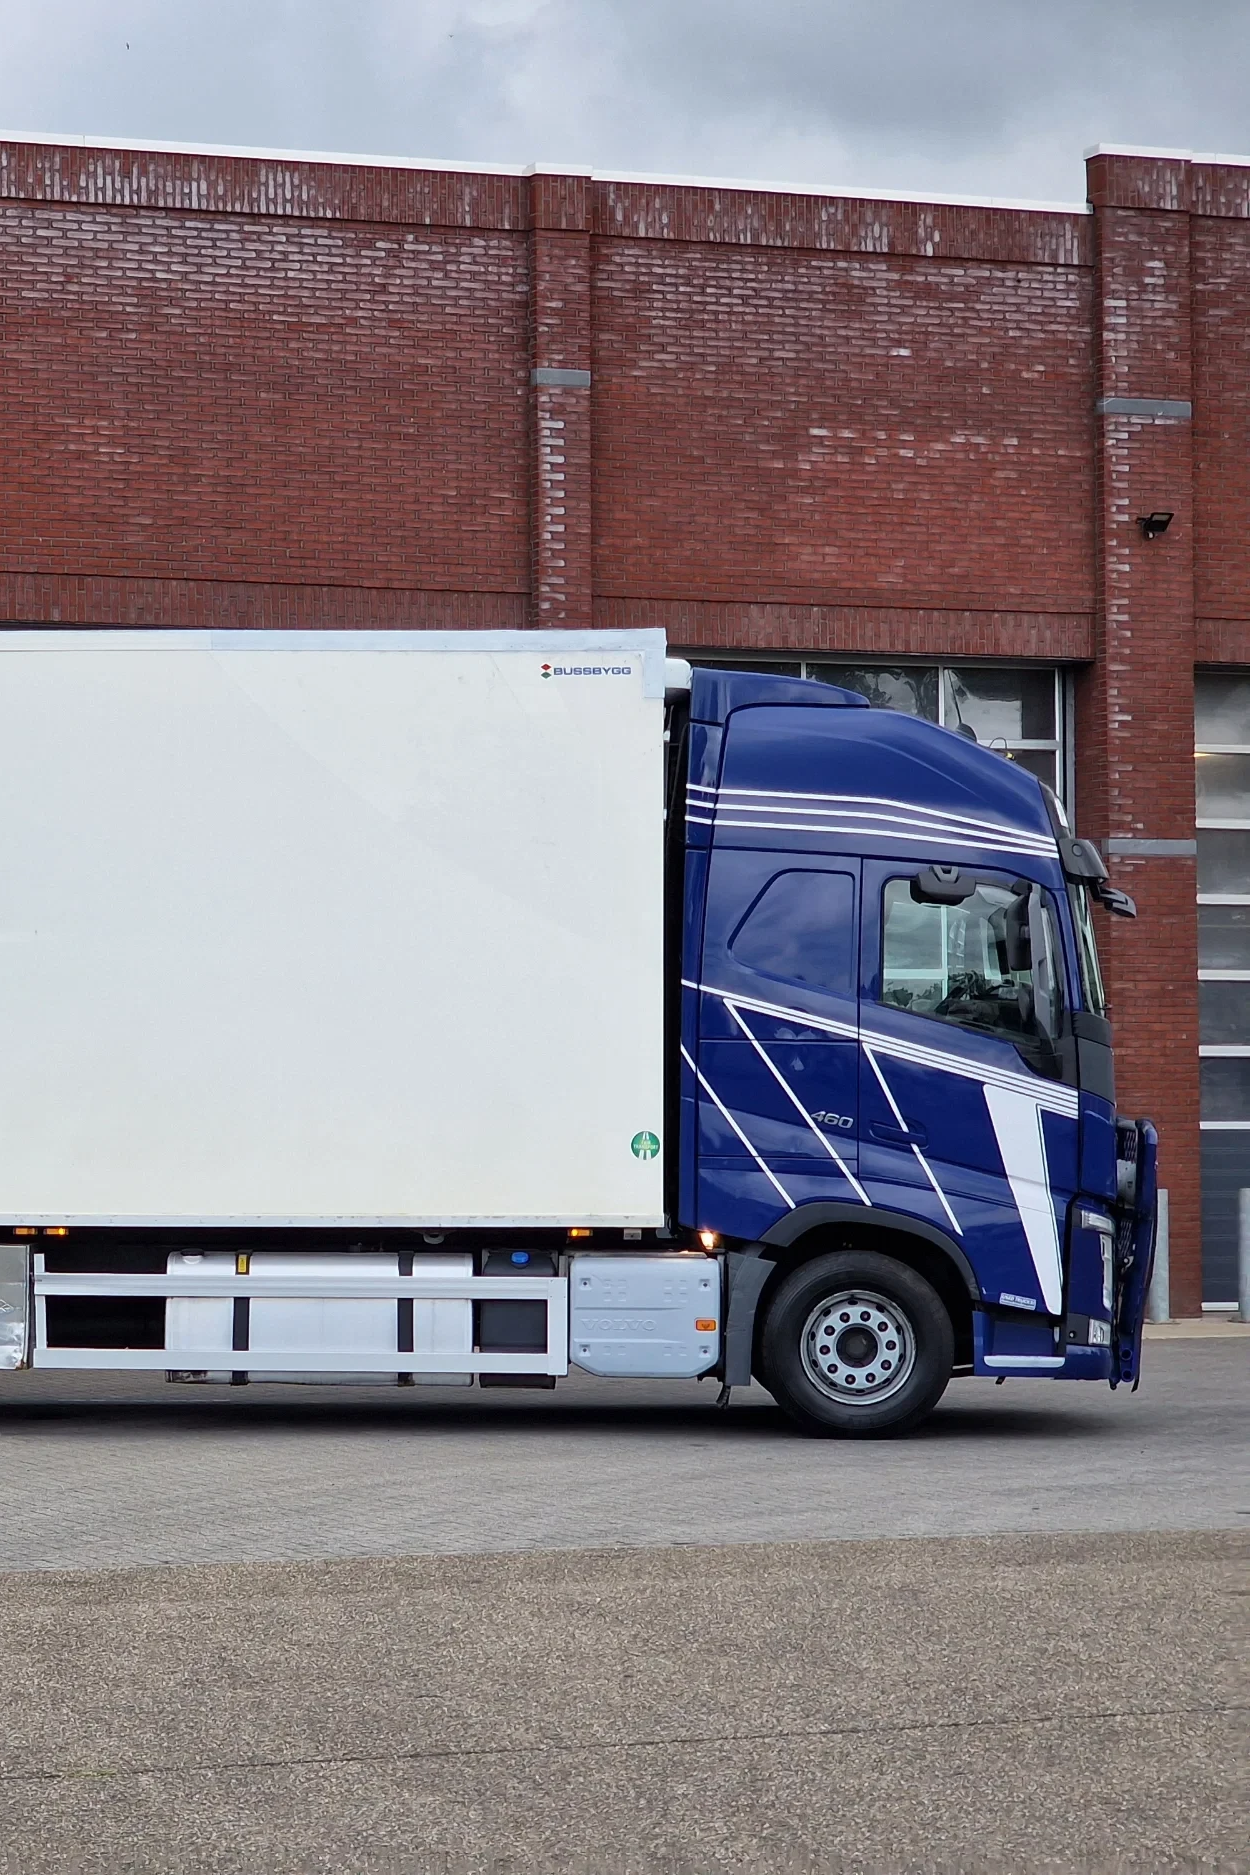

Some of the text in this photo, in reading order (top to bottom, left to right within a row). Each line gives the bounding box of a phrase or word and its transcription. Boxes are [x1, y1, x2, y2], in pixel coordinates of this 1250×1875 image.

[553, 667, 631, 675] BUSSBYGG
[810, 1110, 854, 1129] 460
[580, 1318, 658, 1331] VOLVO
